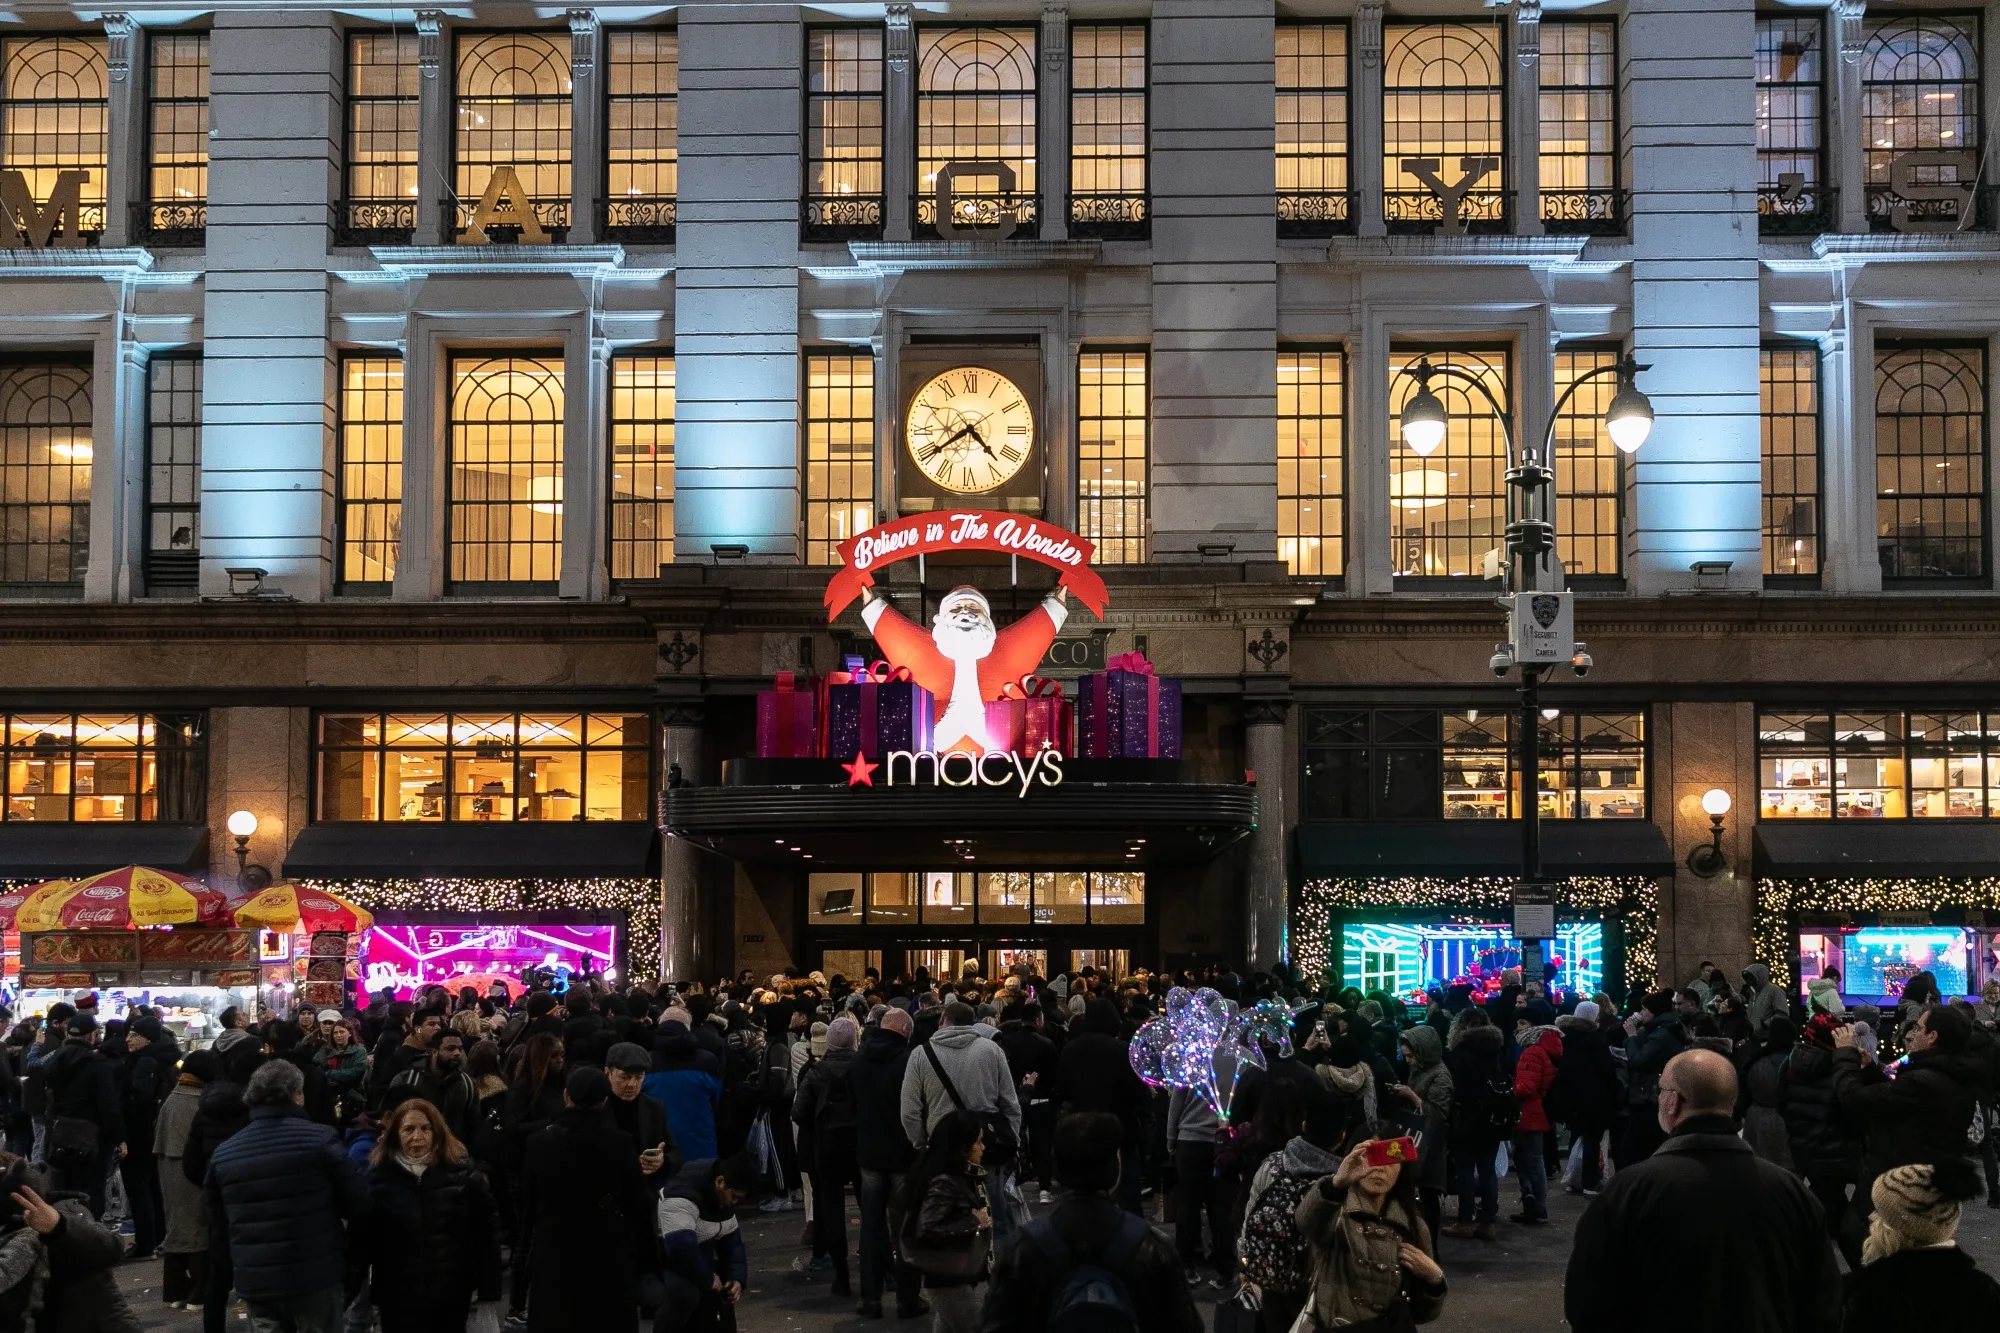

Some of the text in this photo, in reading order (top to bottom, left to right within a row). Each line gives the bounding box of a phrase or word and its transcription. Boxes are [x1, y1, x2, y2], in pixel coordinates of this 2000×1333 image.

[854, 514, 1083, 570] Believe in The Wonder
[1533, 630, 1558, 639] SECURITY
[1050, 641, 1088, 664] CO
[1535, 648, 1558, 657] CAMERA
[161, 907, 194, 916] Sausages
